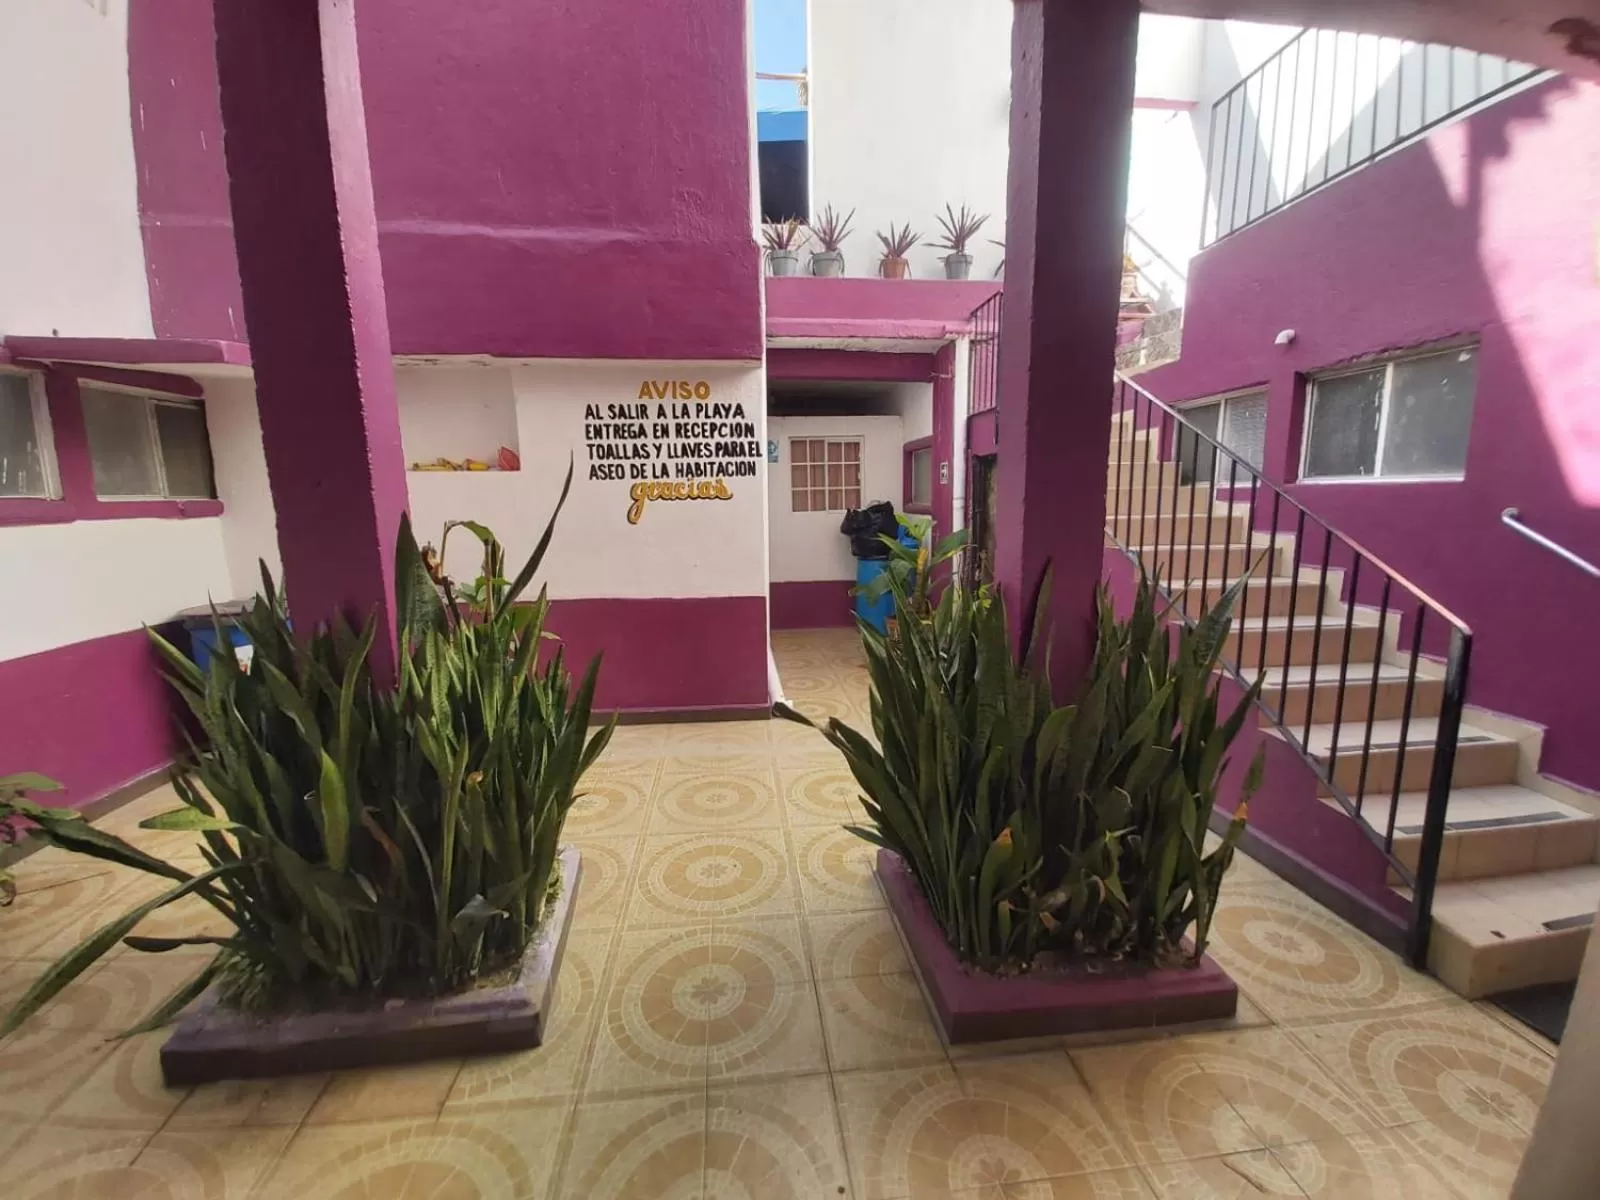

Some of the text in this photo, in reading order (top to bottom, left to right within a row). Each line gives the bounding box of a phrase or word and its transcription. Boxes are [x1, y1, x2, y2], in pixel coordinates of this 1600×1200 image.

[638, 381, 711, 400] AVISO
[585, 403, 745, 420] AL SALIR A LA PLAYA
[585, 422, 755, 440] ENTREGA EN RECEPCION
[587, 443, 650, 460] TOALLAS
[653, 443, 662, 458] Y
[667, 443, 713, 459] LLAVES
[589, 461, 756, 480] ASEO DE LA HABITACION
[627, 479, 733, 524] gracias
